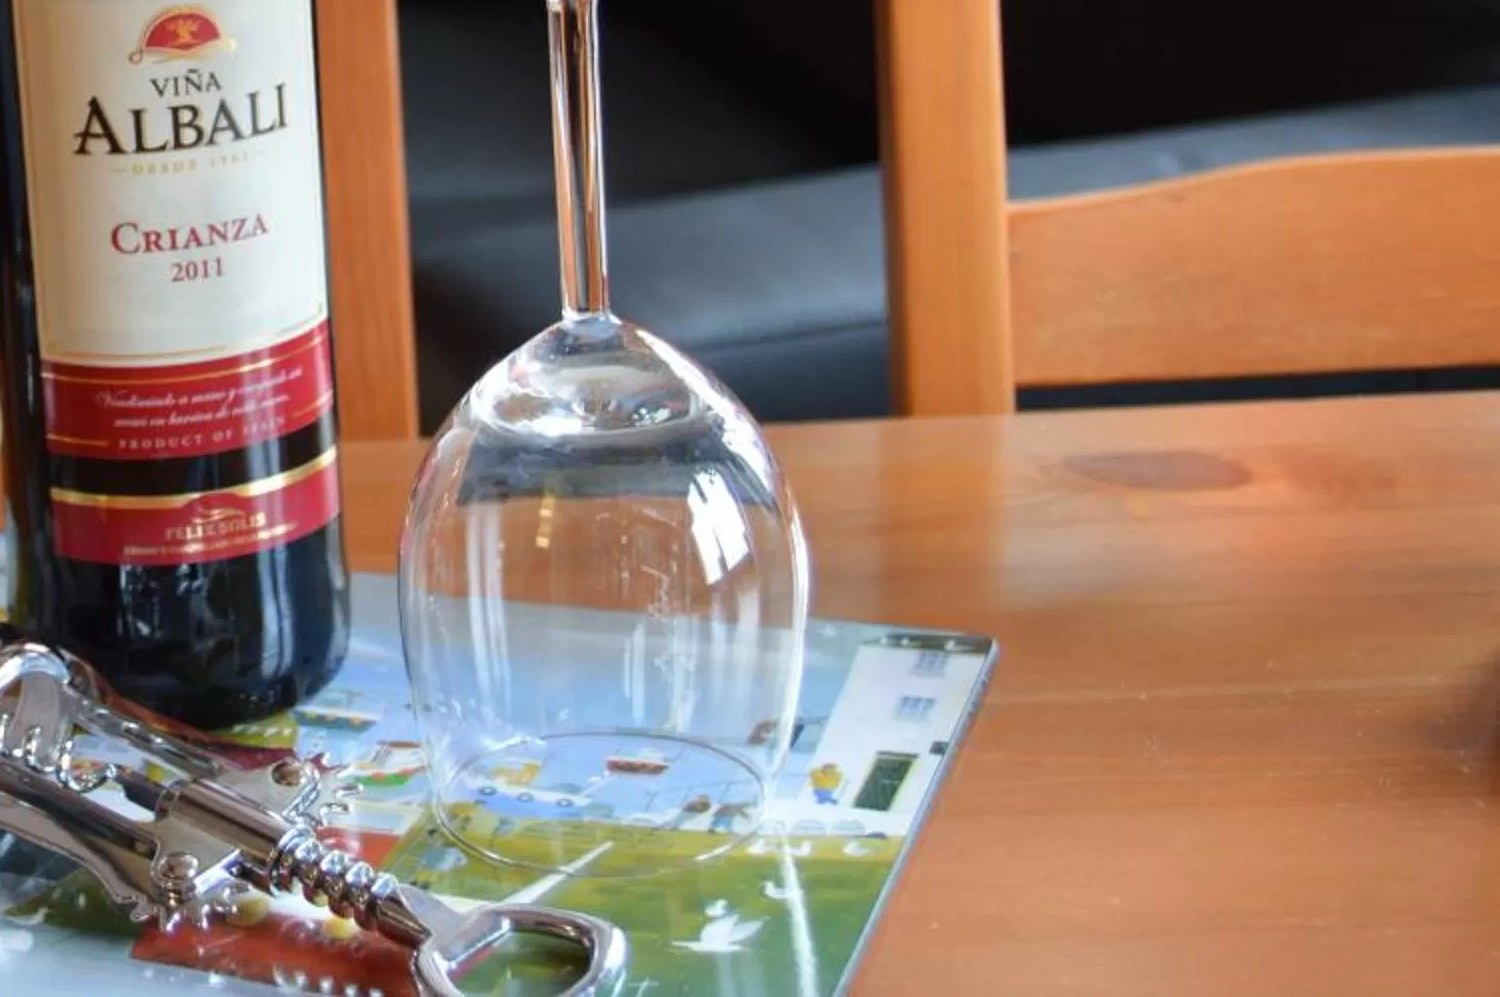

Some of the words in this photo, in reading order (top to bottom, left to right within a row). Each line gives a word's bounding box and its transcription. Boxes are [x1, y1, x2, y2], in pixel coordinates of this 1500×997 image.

[150, 67, 222, 99] VIÑA
[72, 82, 289, 156] ALBALI
[111, 211, 269, 254] CRIANZA
[171, 256, 224, 283] 2011
